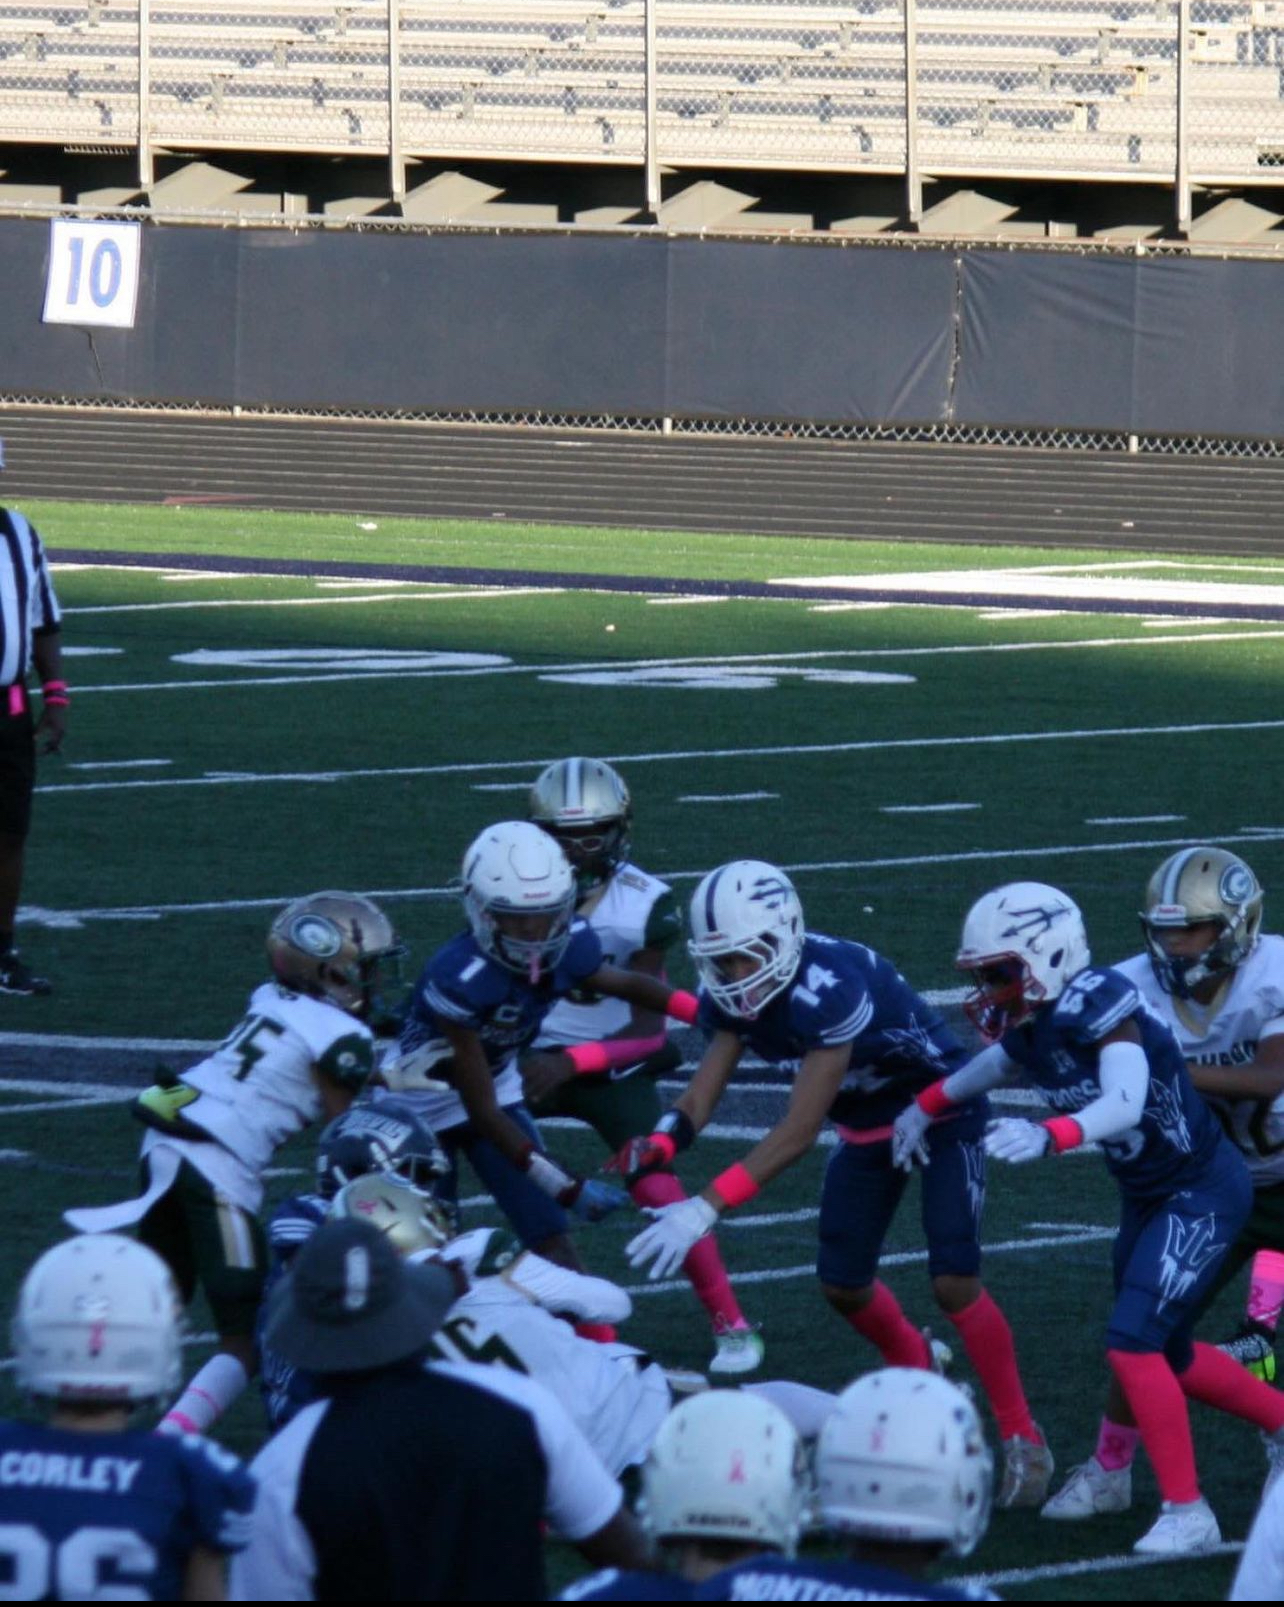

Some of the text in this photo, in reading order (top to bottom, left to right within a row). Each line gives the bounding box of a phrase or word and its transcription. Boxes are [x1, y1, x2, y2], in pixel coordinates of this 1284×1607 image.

[66, 237, 122, 308] 10
[457, 955, 487, 983] 1
[792, 963, 842, 1008] 14
[0, 1451, 142, 1494] CORLEY
